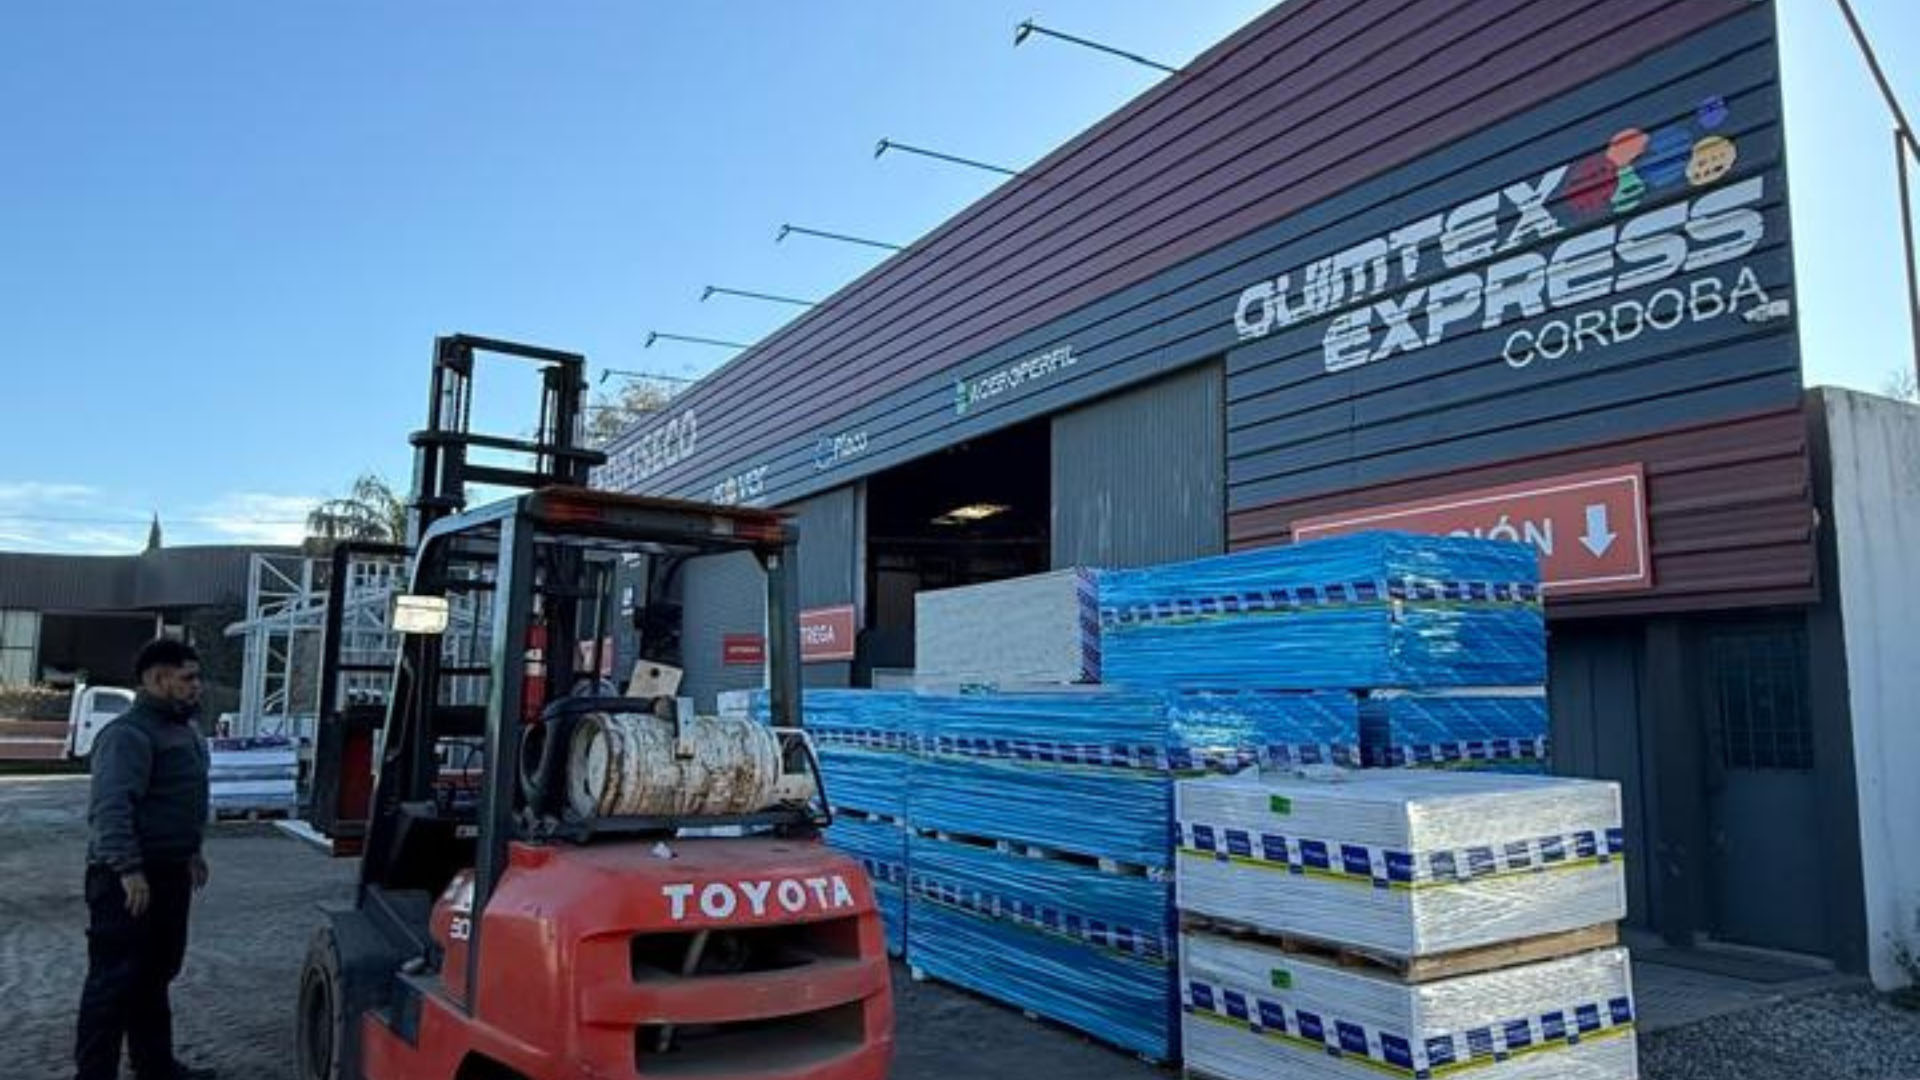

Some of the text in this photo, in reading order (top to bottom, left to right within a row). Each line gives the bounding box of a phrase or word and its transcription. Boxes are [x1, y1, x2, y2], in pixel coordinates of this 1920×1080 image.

[1234, 166, 1569, 341] QUIMTEX
[1323, 176, 1763, 373] EXPRESS
[1503, 266, 1768, 368] CORDOBA
[662, 874, 855, 920] TOYOTA
